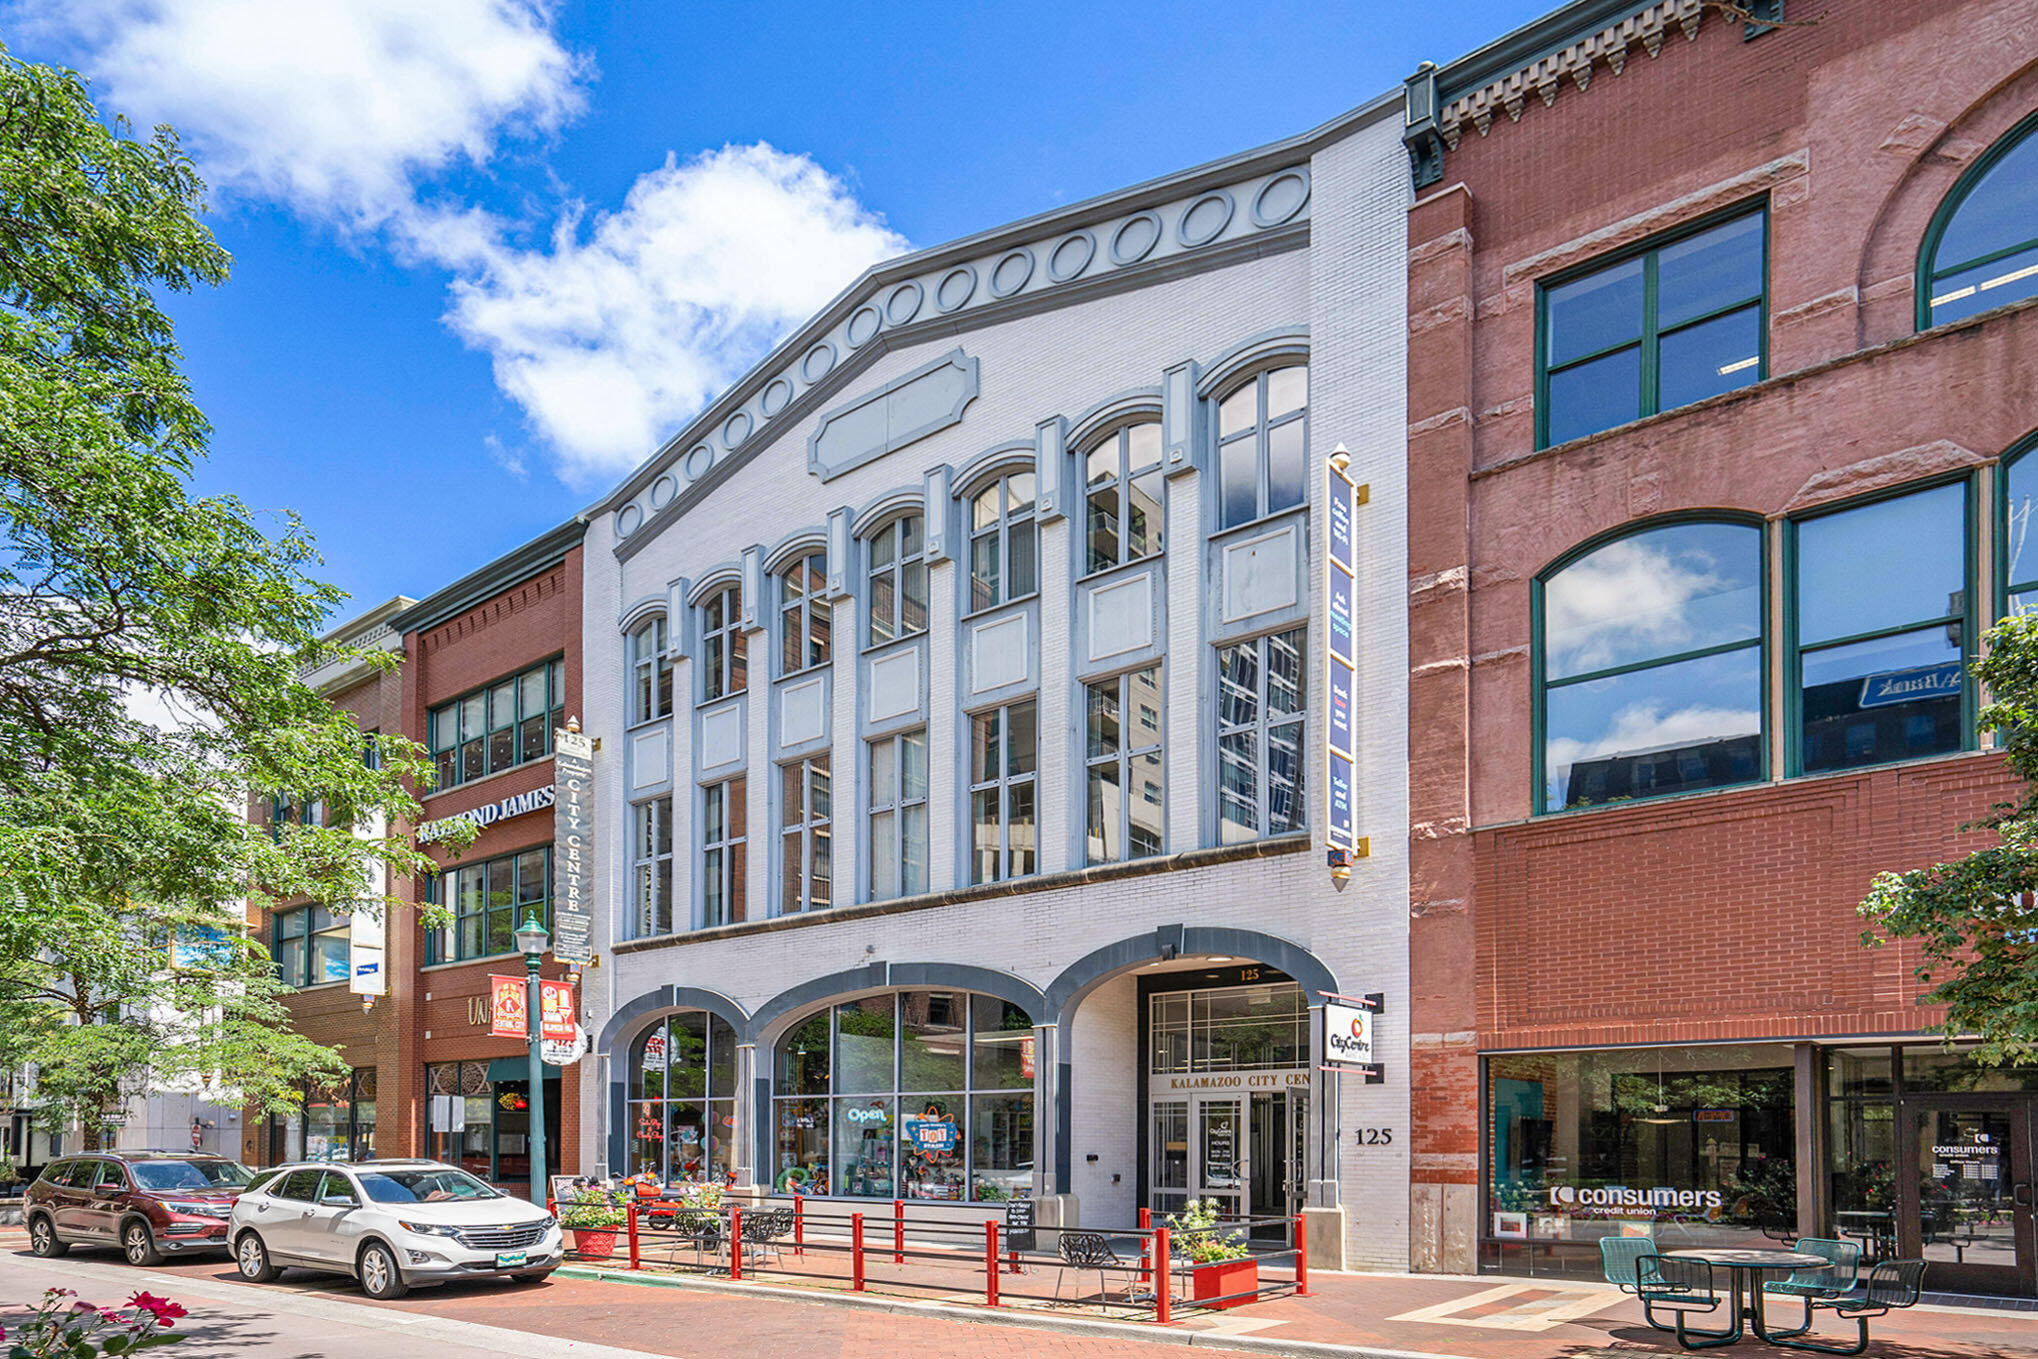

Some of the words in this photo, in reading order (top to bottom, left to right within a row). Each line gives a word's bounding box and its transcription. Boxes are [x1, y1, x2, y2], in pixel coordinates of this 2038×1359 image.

[564, 733, 586, 748] 125
[498, 784, 556, 821] JAMES
[567, 778, 581, 830] CITY
[566, 834, 581, 912] CENTRE
[1241, 968, 1260, 981] 125
[467, 997, 492, 1025] UN
[1170, 1076, 1242, 1089] KALAMAZOO
[1248, 1075, 1278, 1086] CITY
[848, 1108, 887, 1124] Open
[920, 1129, 947, 1143] TOY
[1354, 1127, 1393, 1146] 125
[1931, 1144, 1999, 1155] consumers
[1578, 1187, 1722, 1208] consumers
[1593, 1206, 1624, 1215] credit
[1627, 1207, 1657, 1216] union
